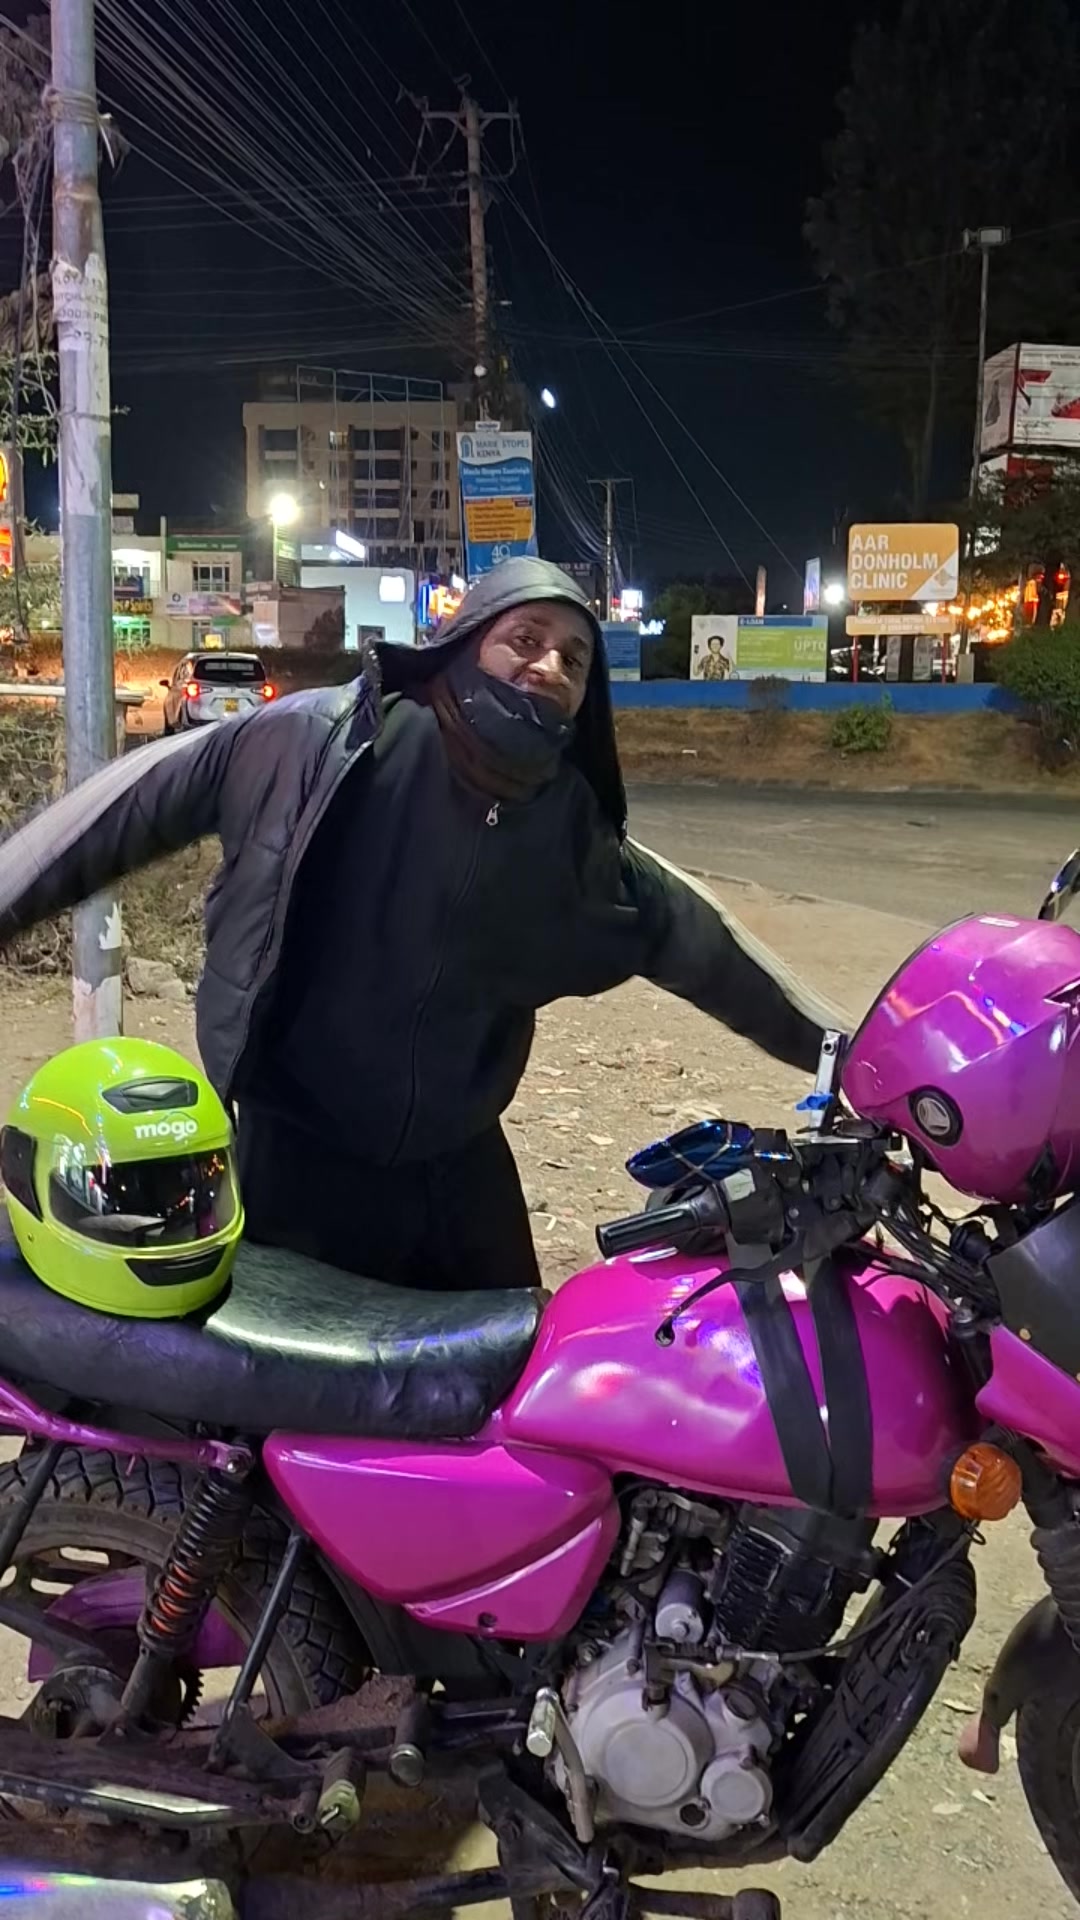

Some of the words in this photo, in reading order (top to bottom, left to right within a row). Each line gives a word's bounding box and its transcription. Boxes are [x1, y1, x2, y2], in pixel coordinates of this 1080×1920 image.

[476, 440, 498, 448] MARIE
[502, 438, 529, 448] STOPES
[477, 449, 502, 457] KENYA
[851, 534, 889, 551] AAR
[851, 552, 939, 570] DONHOLM
[851, 571, 908, 589] CLINIC
[793, 638, 826, 652] UPTO
[133, 1119, 198, 1141] mogo
